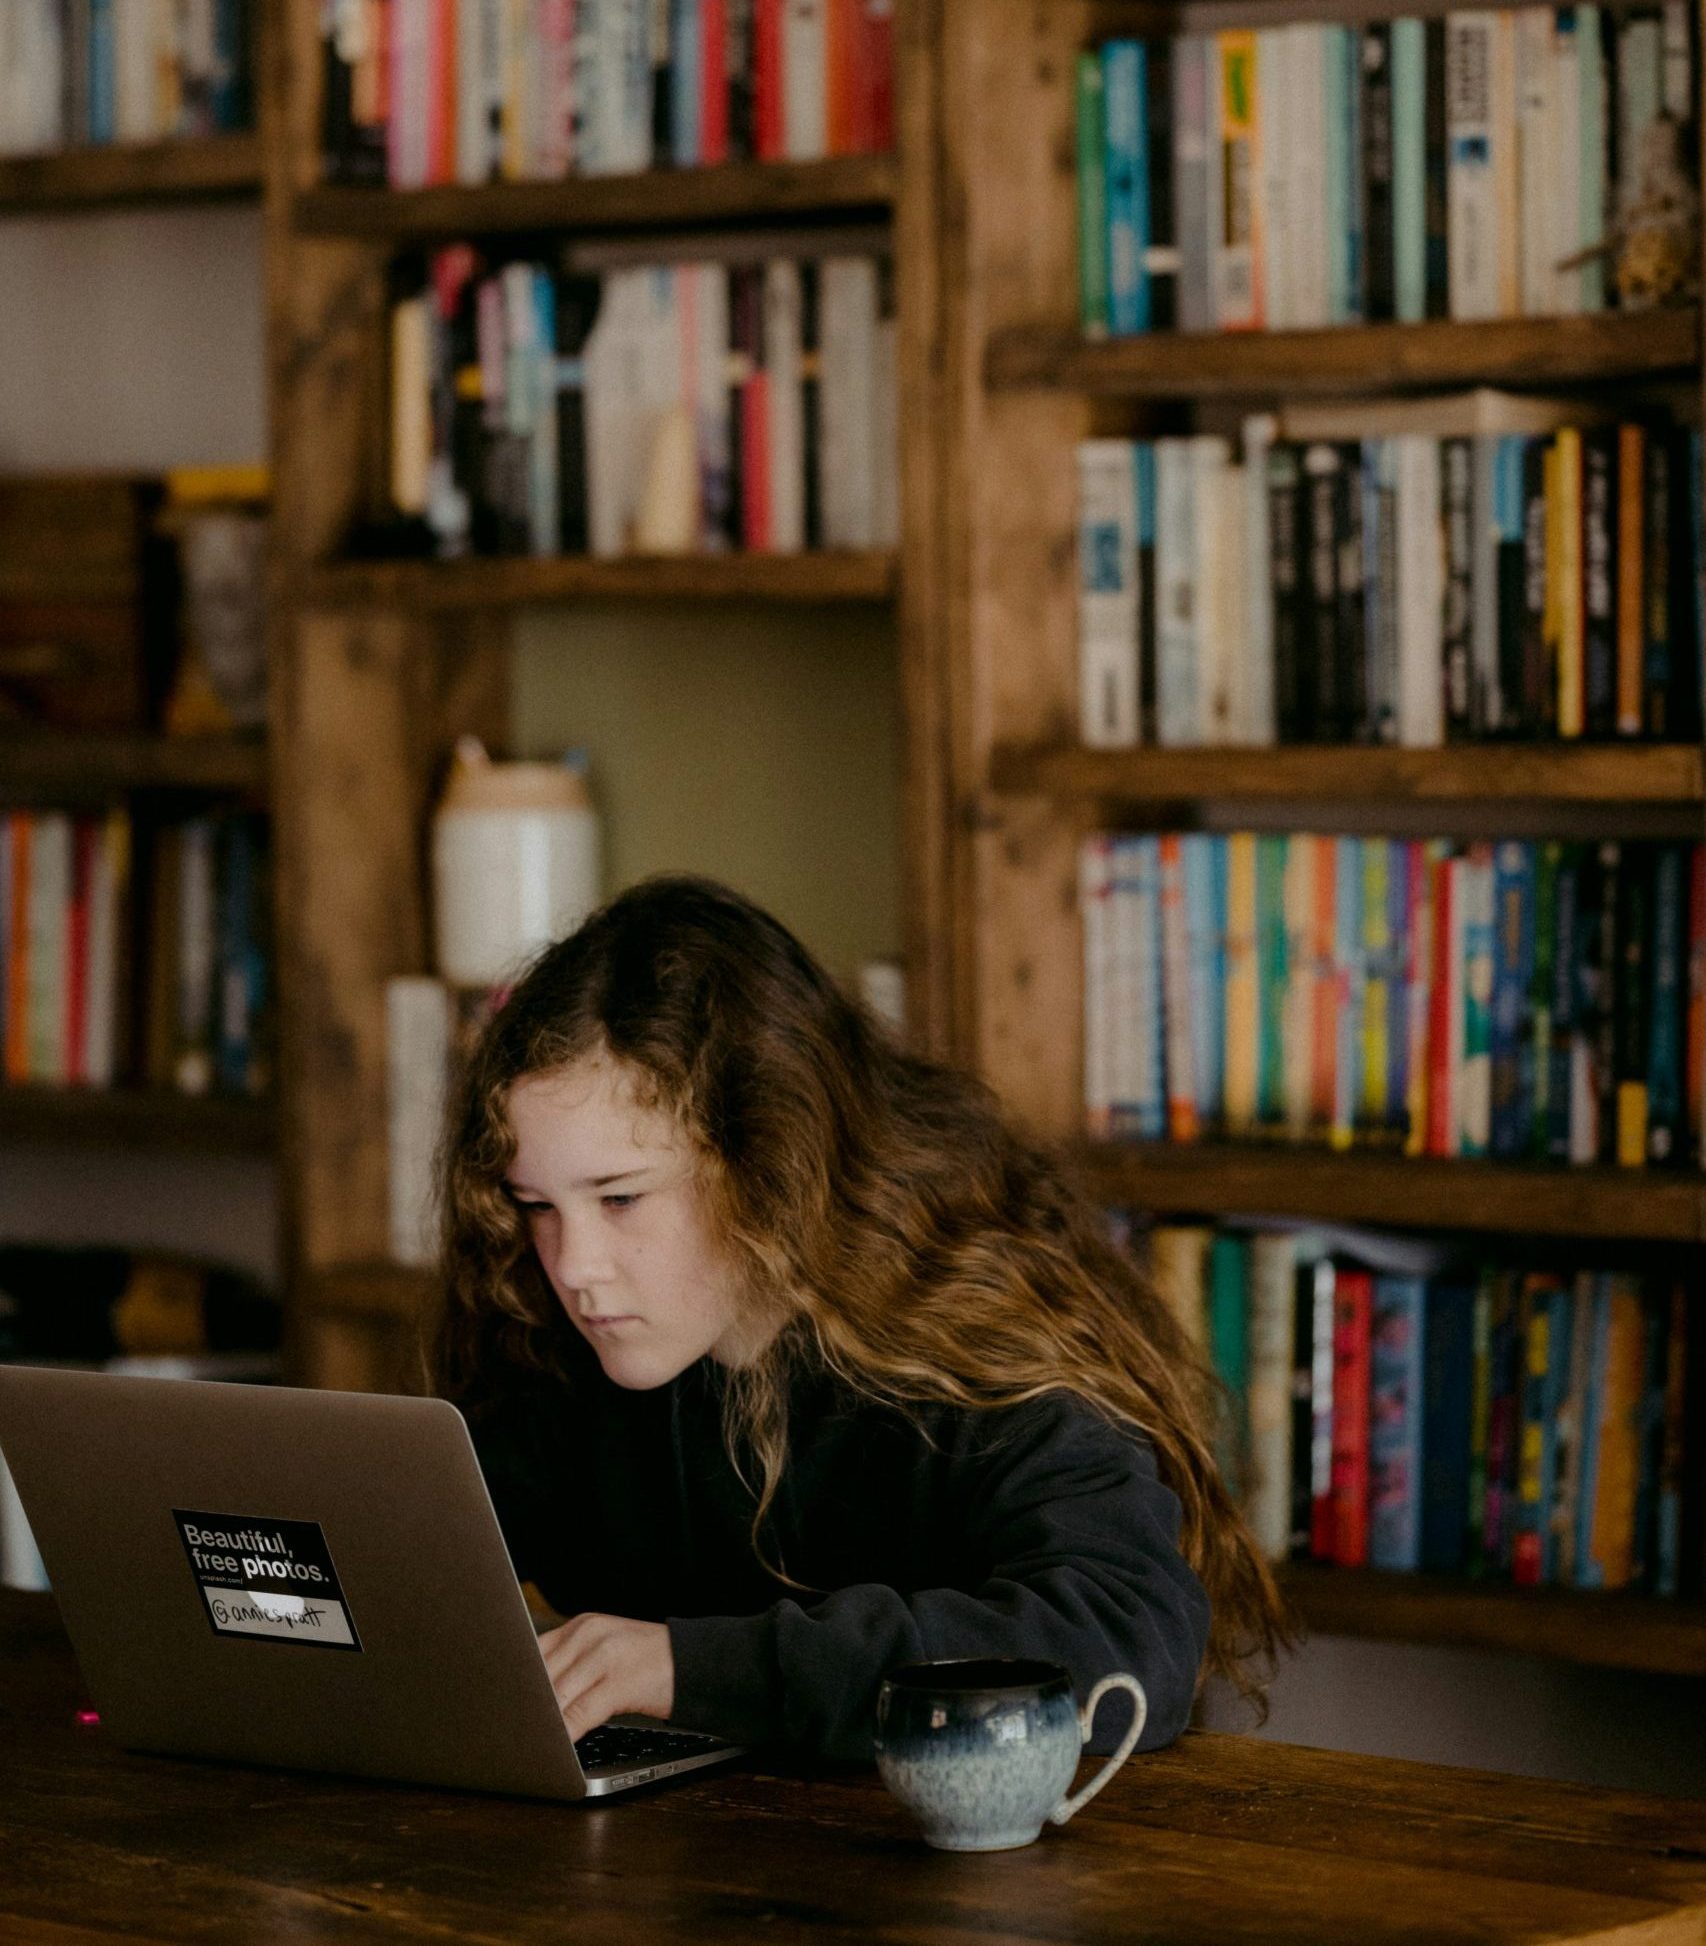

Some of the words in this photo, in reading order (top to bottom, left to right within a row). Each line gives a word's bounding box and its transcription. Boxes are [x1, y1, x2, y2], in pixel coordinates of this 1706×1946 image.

[184, 1524, 293, 1559] Beautiful,
[192, 1548, 239, 1573] free
[242, 1555, 330, 1583] photos.
